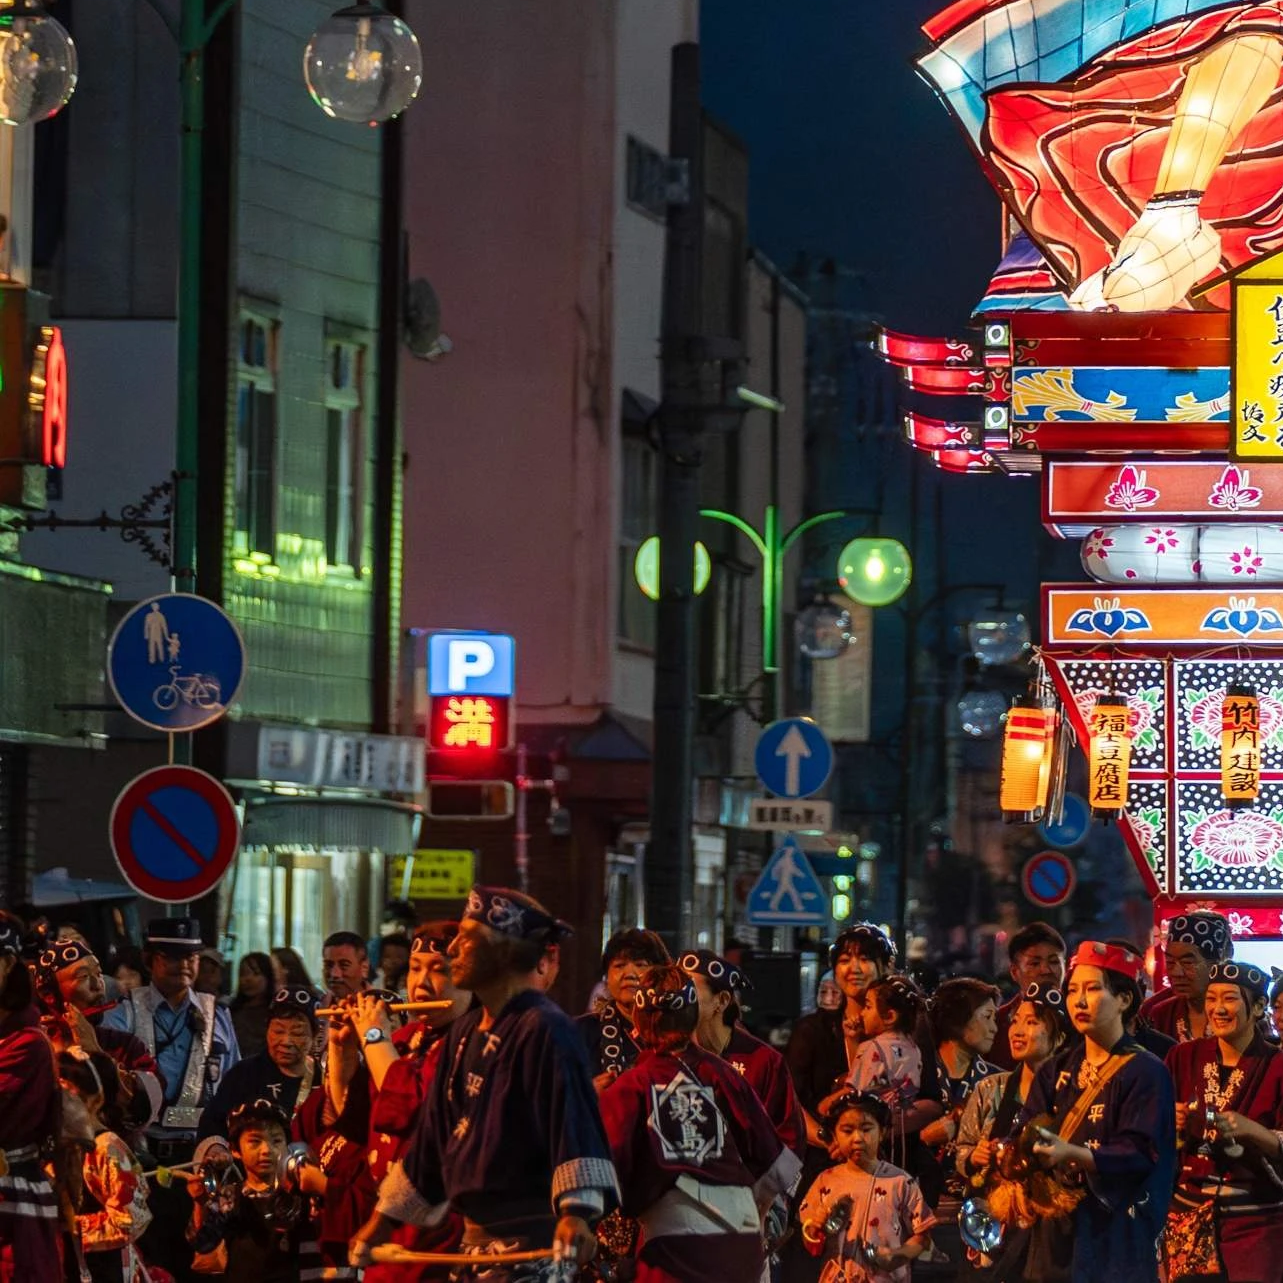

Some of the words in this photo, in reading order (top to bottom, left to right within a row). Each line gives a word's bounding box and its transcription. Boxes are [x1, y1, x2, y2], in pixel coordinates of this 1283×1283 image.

[448, 640, 495, 692] P
[444, 697, 495, 747] 満
[1227, 702, 1258, 792] 竹内建設
[1094, 714, 1125, 800] 福士豆腐店
[267, 1083, 283, 1099] 下
